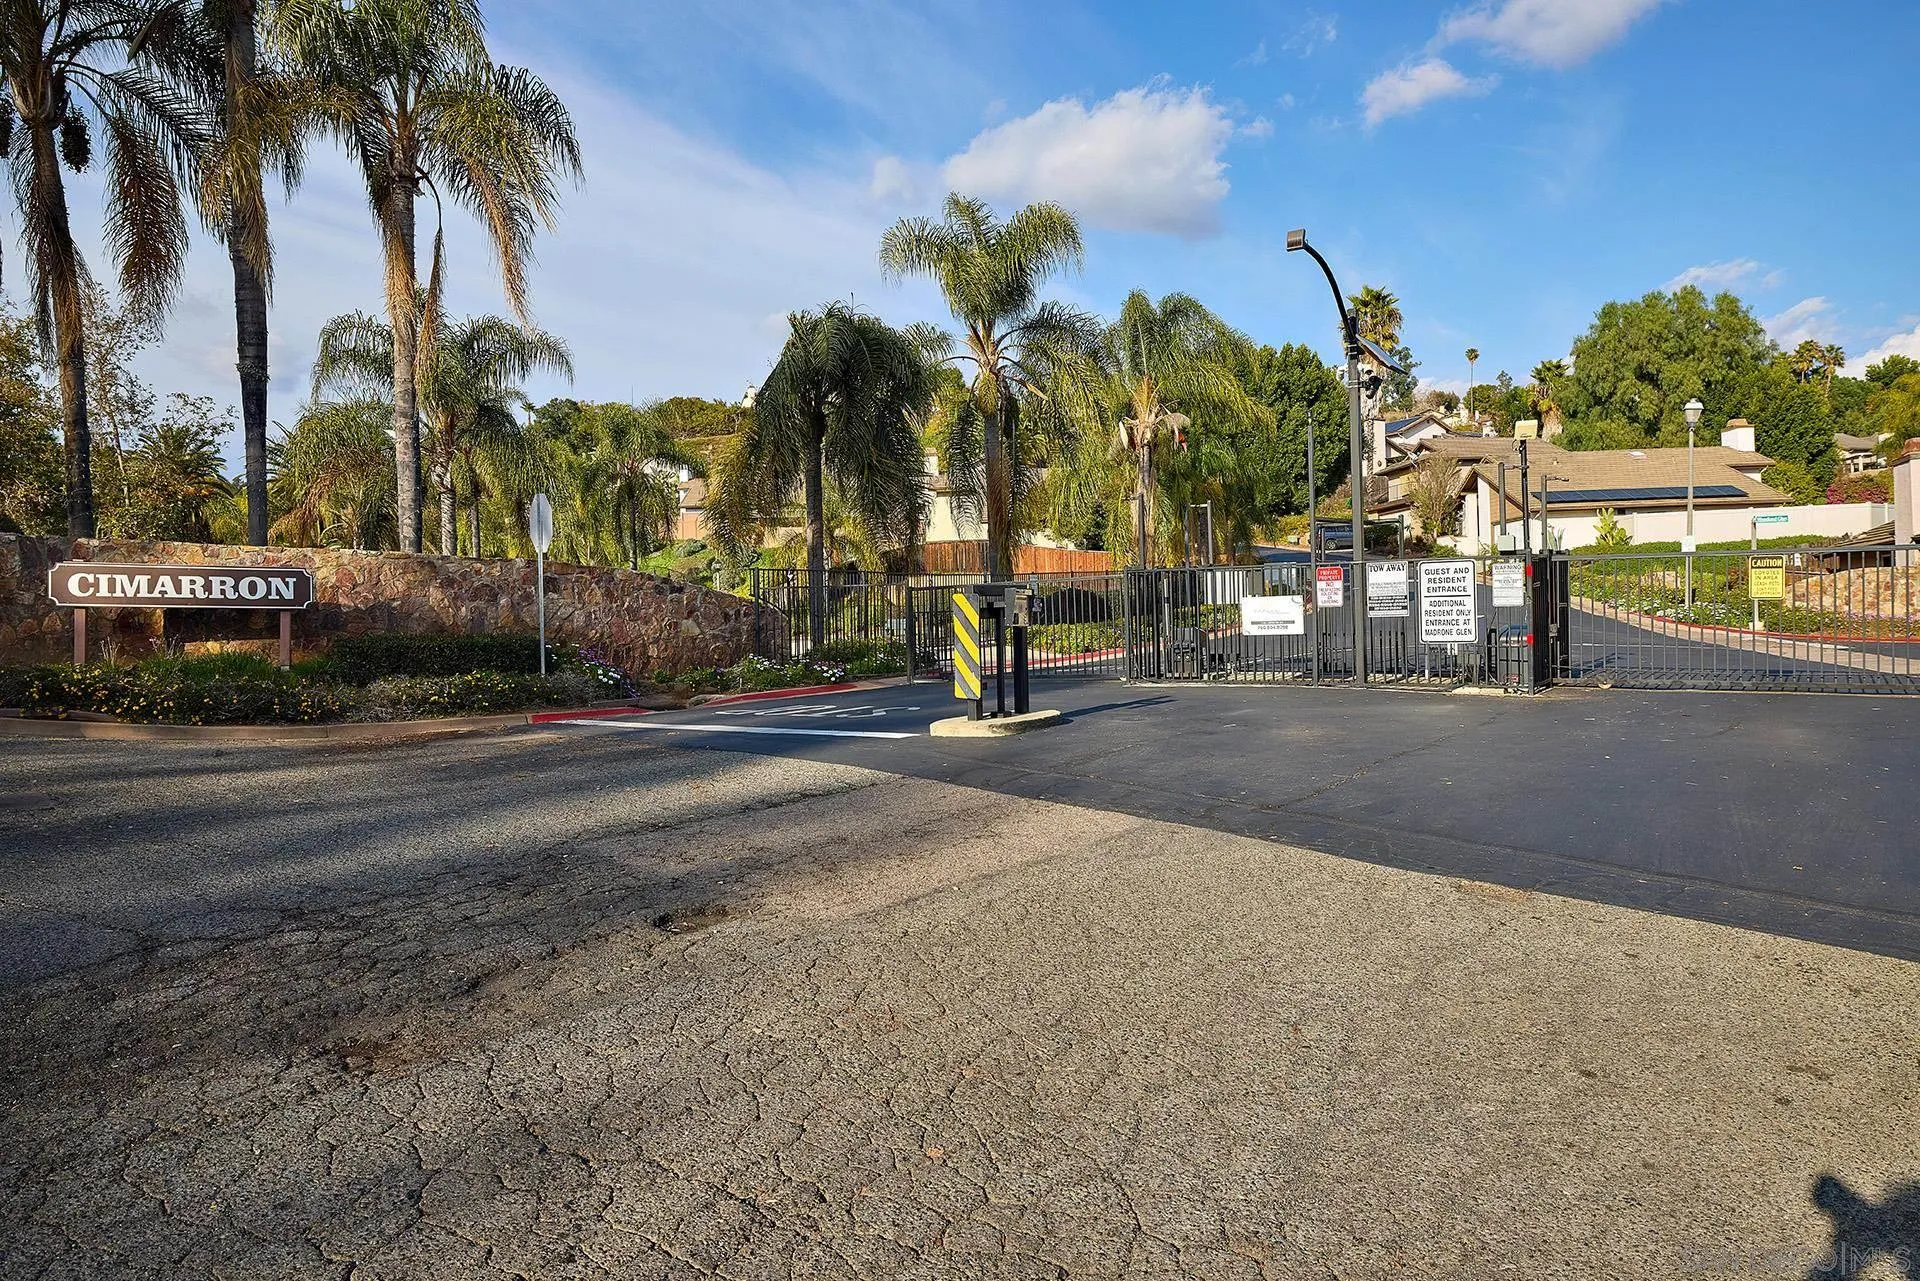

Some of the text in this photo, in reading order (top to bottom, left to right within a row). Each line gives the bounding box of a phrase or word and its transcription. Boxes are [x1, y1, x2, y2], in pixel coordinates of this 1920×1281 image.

[1752, 559, 1782, 567] CAUTION
[1369, 563, 1406, 573] TOW AWAY
[1427, 576, 1467, 584] RESIDENT
[67, 573, 297, 600] CIMARRON
[1424, 609, 1453, 617] RESIDENT
[1462, 618, 1471, 626] AT
[1424, 628, 1472, 636] MADRONE GLEN
